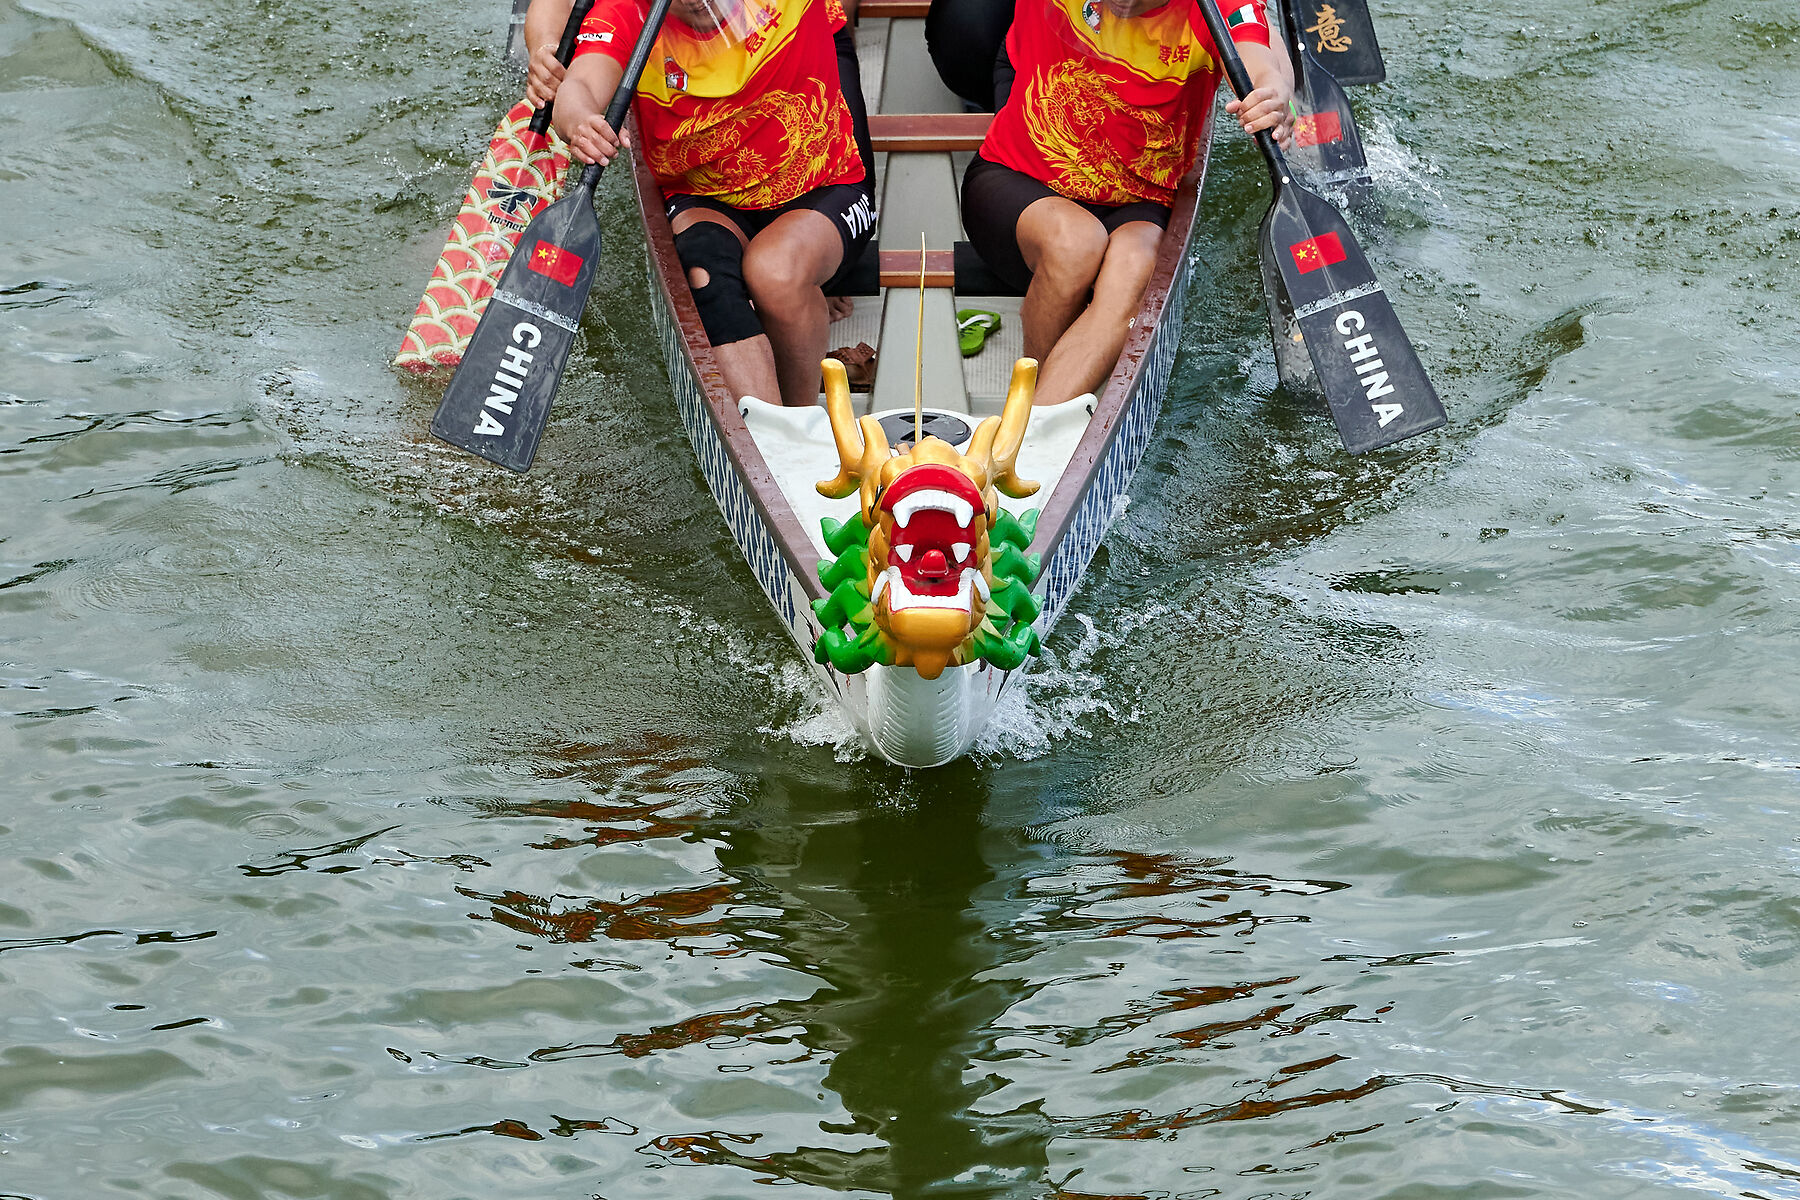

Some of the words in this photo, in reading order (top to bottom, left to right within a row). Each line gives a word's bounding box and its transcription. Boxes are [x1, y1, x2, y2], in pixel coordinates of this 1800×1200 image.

[488, 212, 524, 232] hornet
[473, 322, 542, 436] CHINA
[1335, 310, 1404, 429] CHINA
